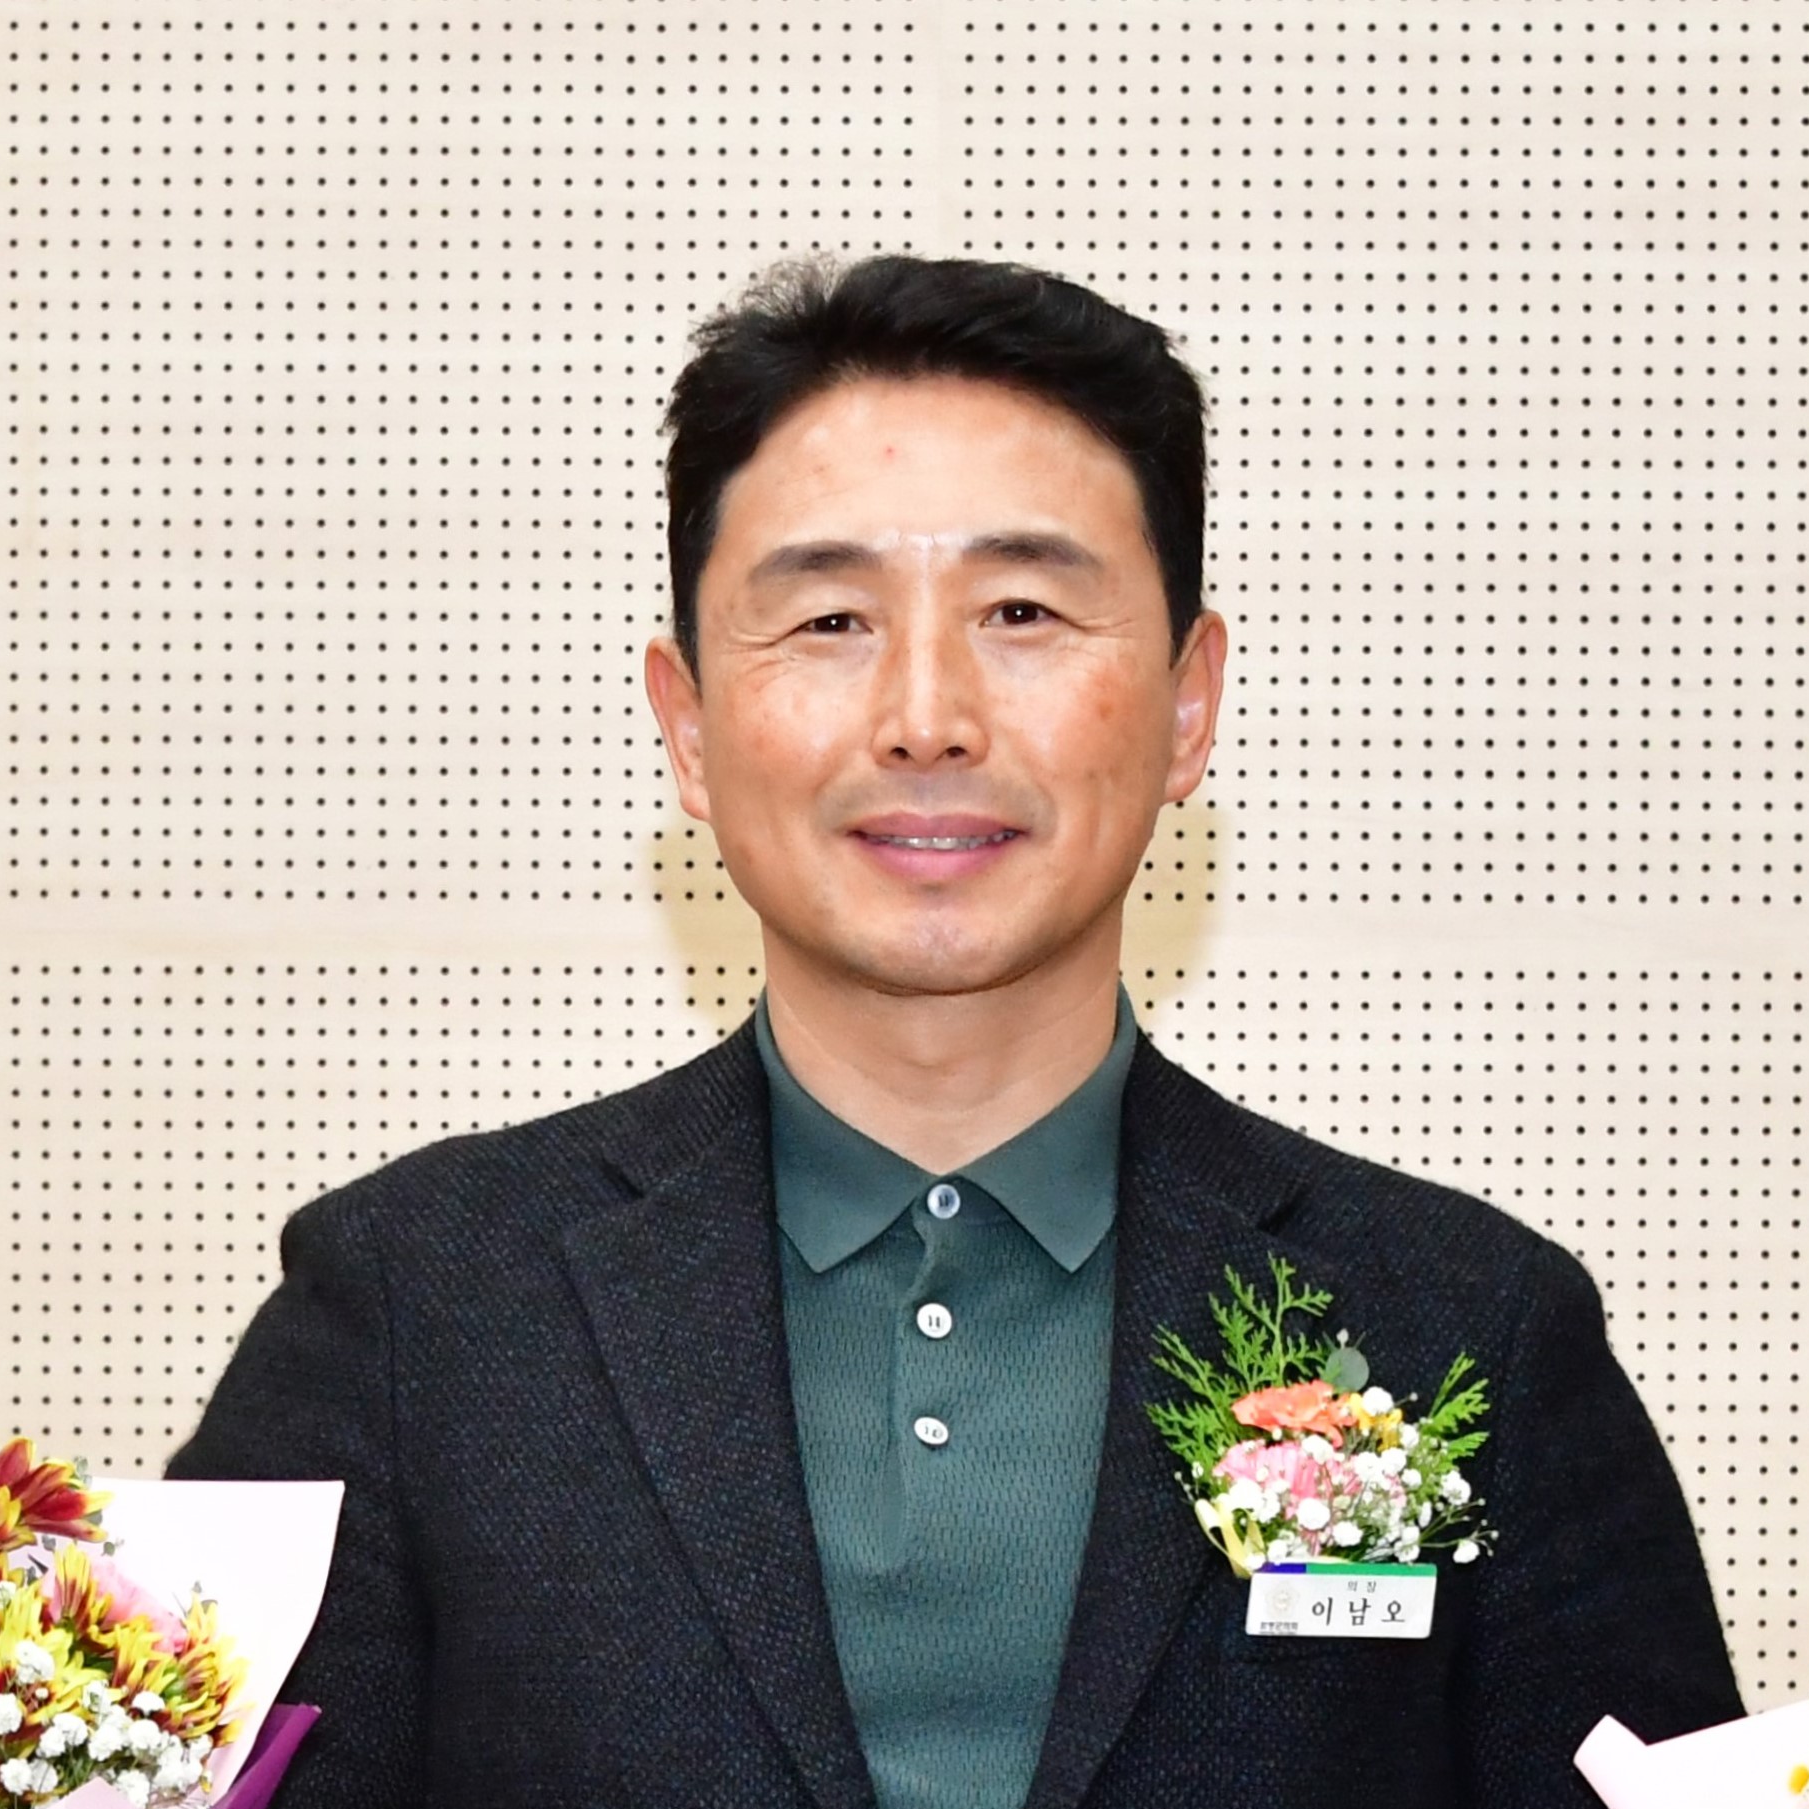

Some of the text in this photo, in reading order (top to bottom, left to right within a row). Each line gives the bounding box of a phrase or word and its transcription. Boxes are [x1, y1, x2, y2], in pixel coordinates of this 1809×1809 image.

[1311, 1596, 1405, 1627] 이 남 오
